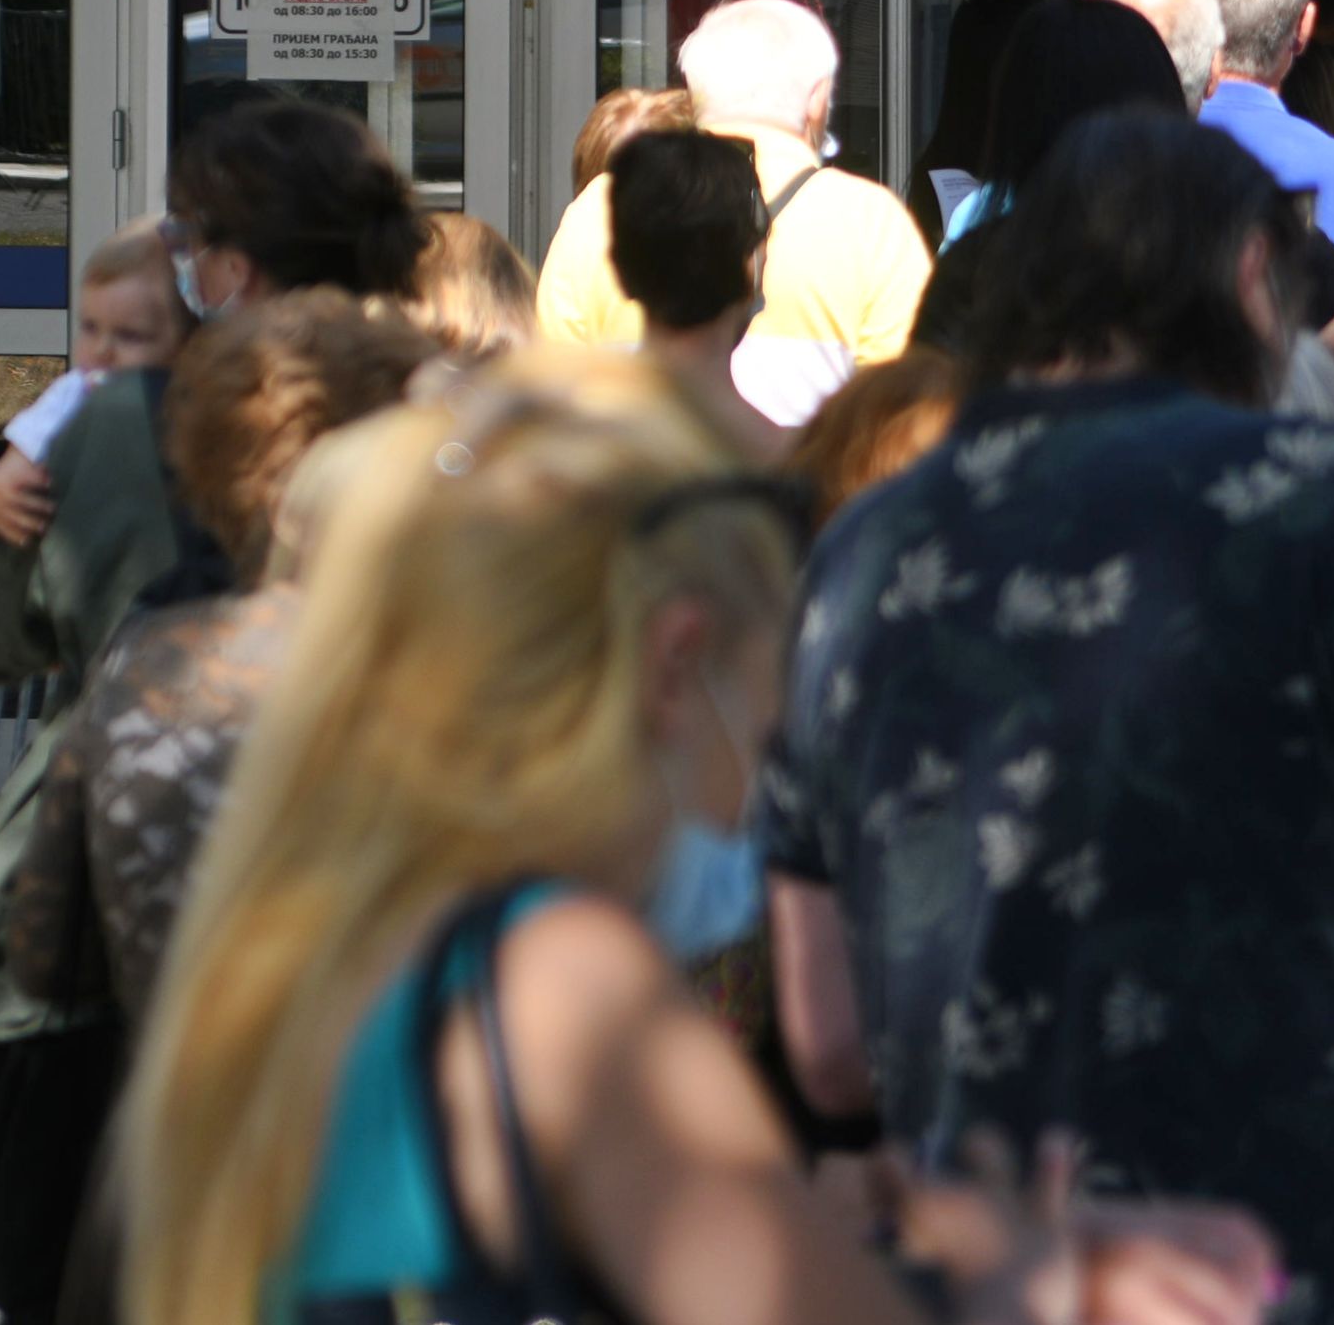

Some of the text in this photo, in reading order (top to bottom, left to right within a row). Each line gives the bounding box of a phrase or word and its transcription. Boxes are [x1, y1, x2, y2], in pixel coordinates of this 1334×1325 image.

[274, 6, 378, 16] од 08:30 до 16:00
[273, 34, 379, 45] ПРИЈЕМ ГРАЂАНА
[274, 49, 378, 59] од 08:30 до 15:30
